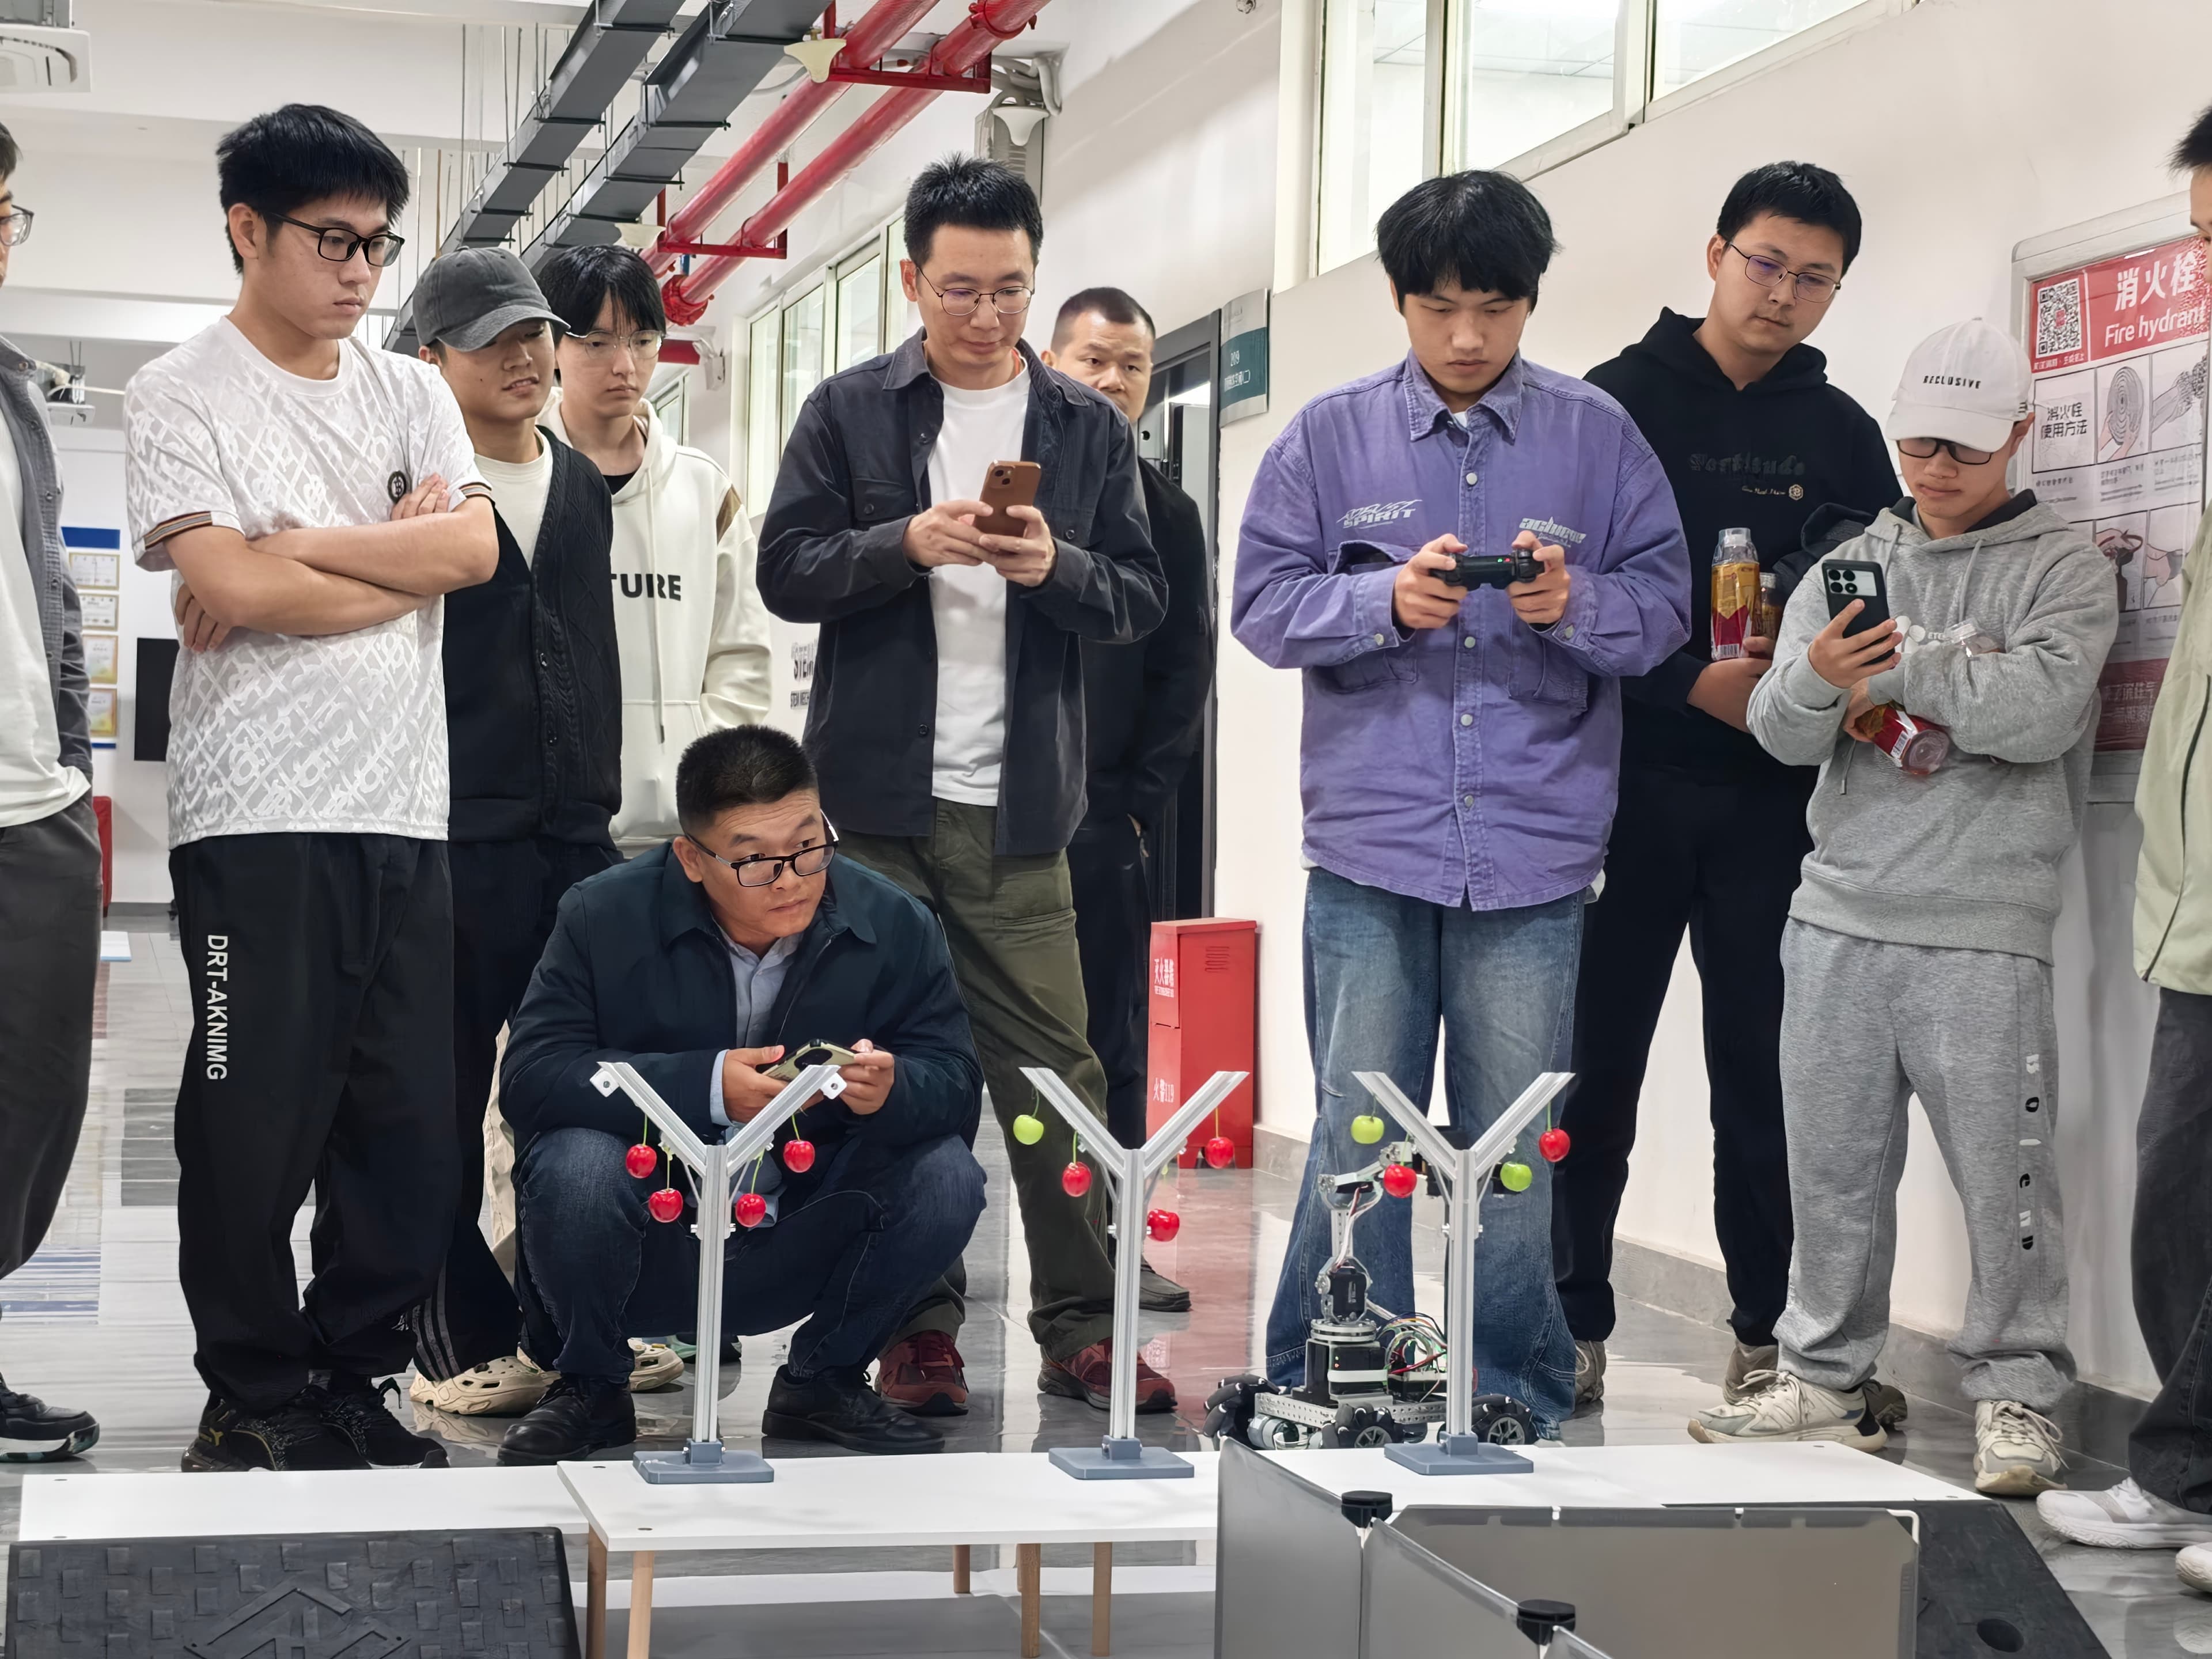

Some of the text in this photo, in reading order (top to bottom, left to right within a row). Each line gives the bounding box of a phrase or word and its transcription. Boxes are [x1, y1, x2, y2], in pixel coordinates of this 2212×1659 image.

[2115, 252, 2198, 312] 消火栓
[2104, 298, 2206, 347] Fire hydrant
[2047, 402, 2082, 421] 消火栓
[2041, 419, 2088, 439] 使用方法
[1343, 508, 1416, 527] SPIRIT
[206, 935, 228, 1080] DRT-AKNIMG
